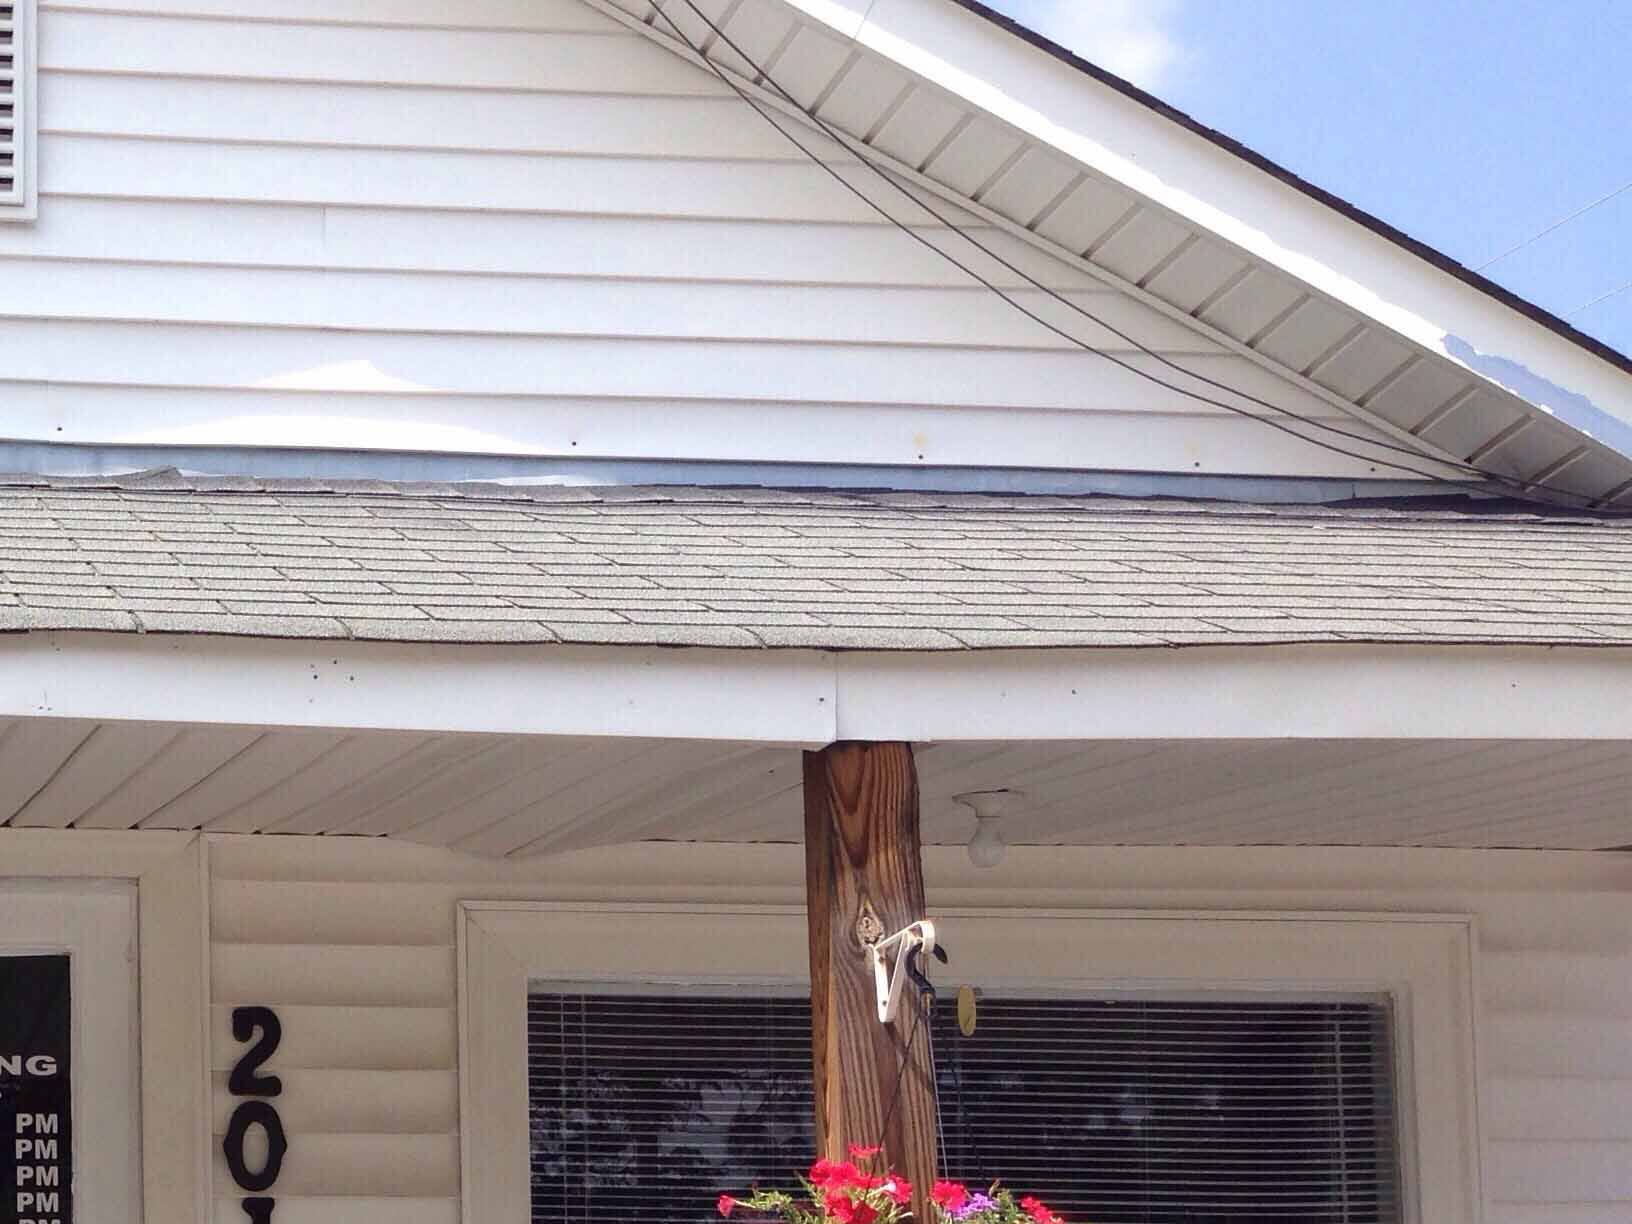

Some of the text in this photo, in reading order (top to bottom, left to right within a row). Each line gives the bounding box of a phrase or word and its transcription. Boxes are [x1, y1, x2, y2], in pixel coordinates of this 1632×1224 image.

[15, 1113, 59, 1134] PM
[15, 1139, 58, 1159] PM
[16, 1166, 59, 1186] PM
[16, 1192, 60, 1213] PM
